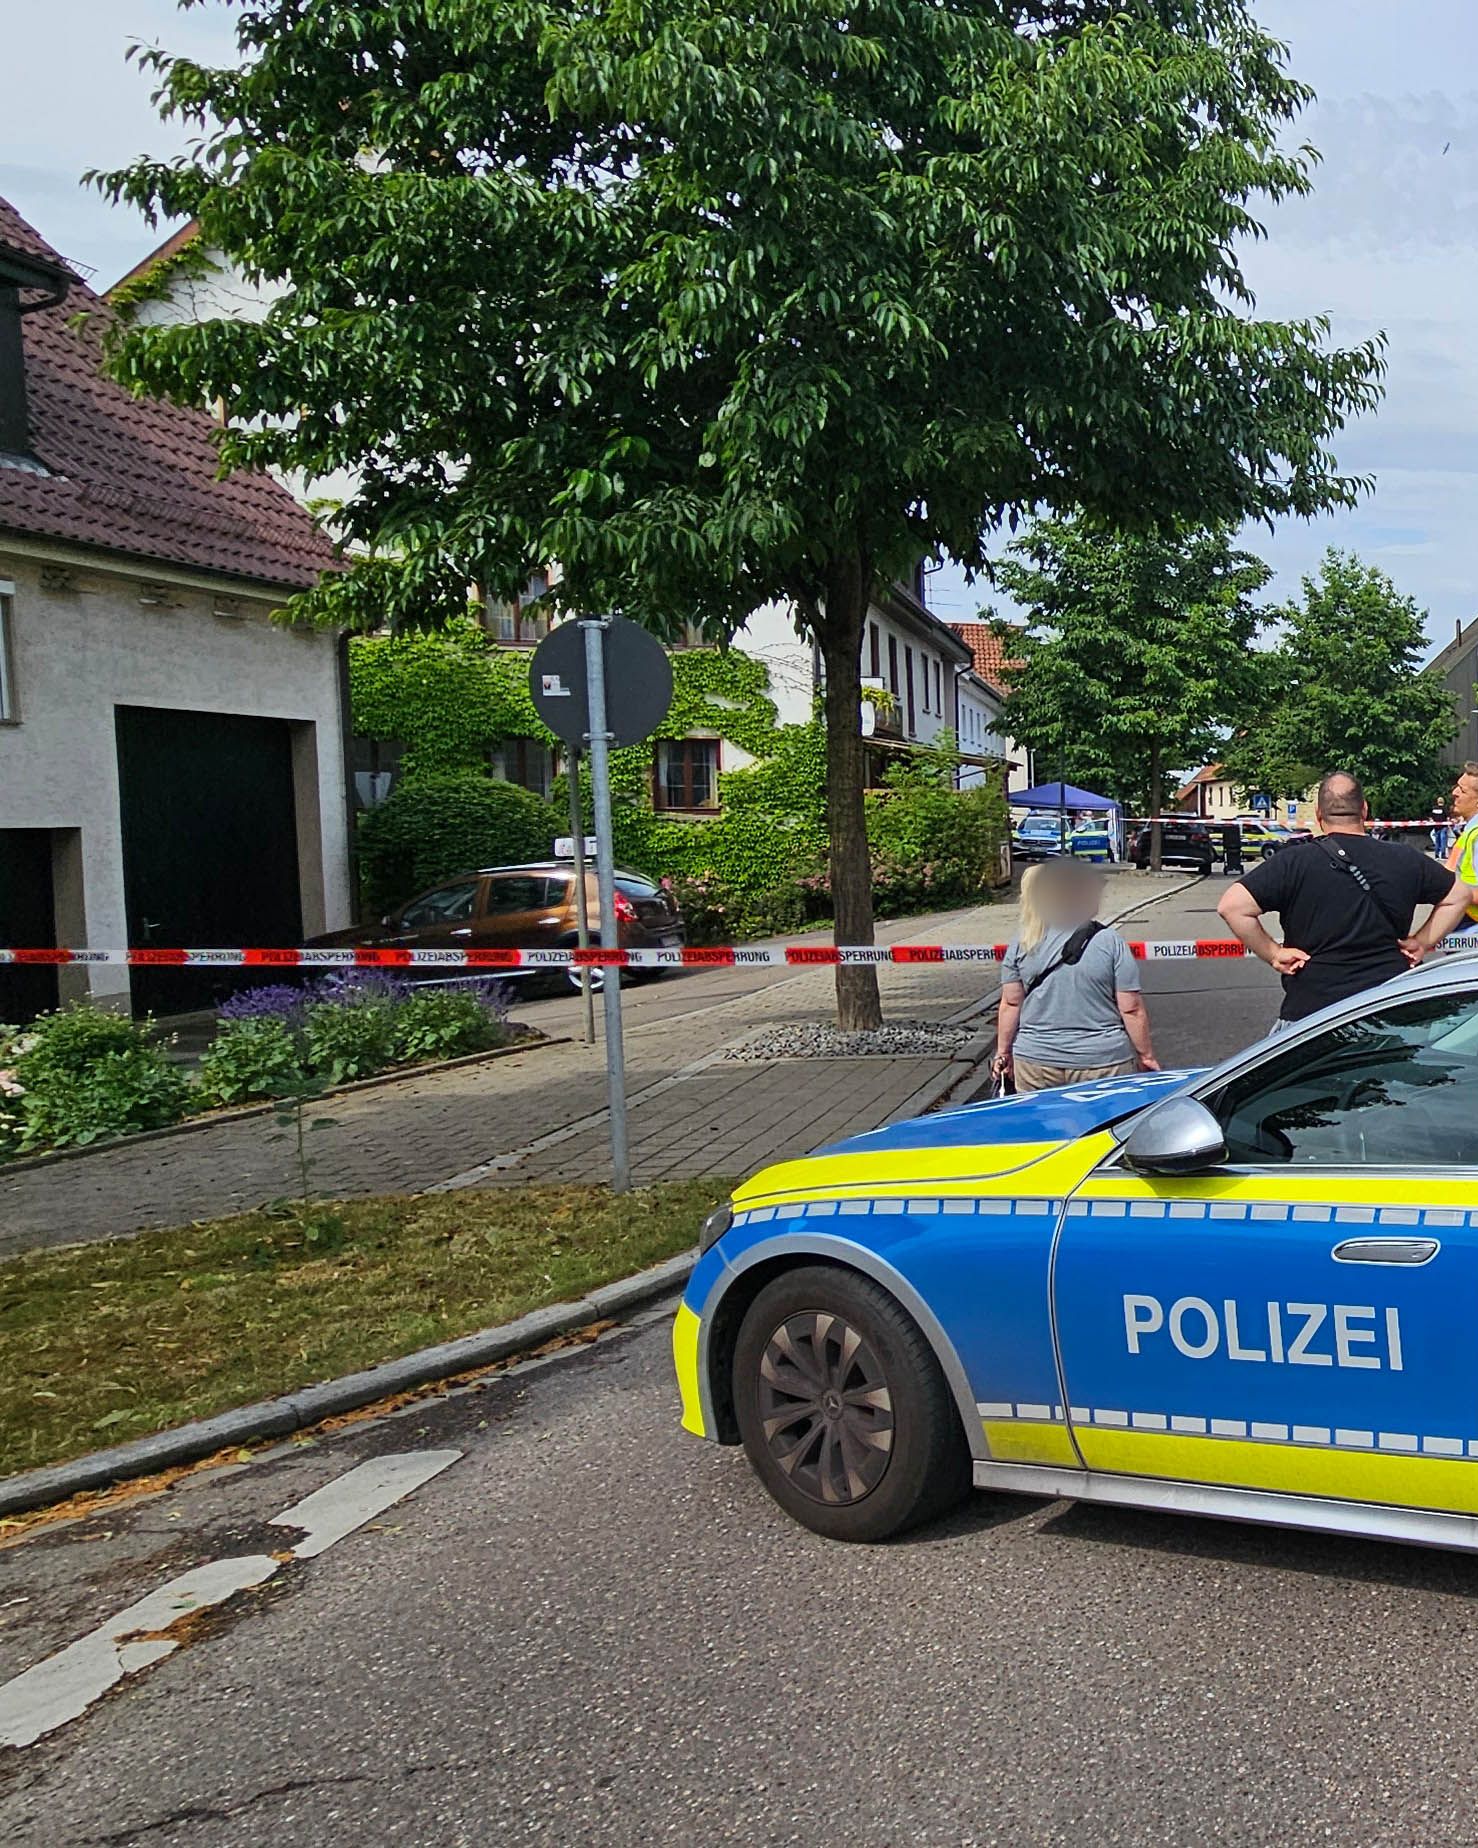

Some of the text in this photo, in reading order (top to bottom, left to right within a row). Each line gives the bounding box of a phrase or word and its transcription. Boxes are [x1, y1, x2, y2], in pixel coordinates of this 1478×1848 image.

[657, 950, 770, 962] POLIZEIABSPERRUNG
[785, 949, 895, 962] POLIZEIABSPERRUNG
[909, 948, 1004, 962] POLIZEIABSPERRU
[1153, 943, 1257, 957] POLIZEIABSPERRUN
[1123, 1294, 1403, 1371] POLIZEI
